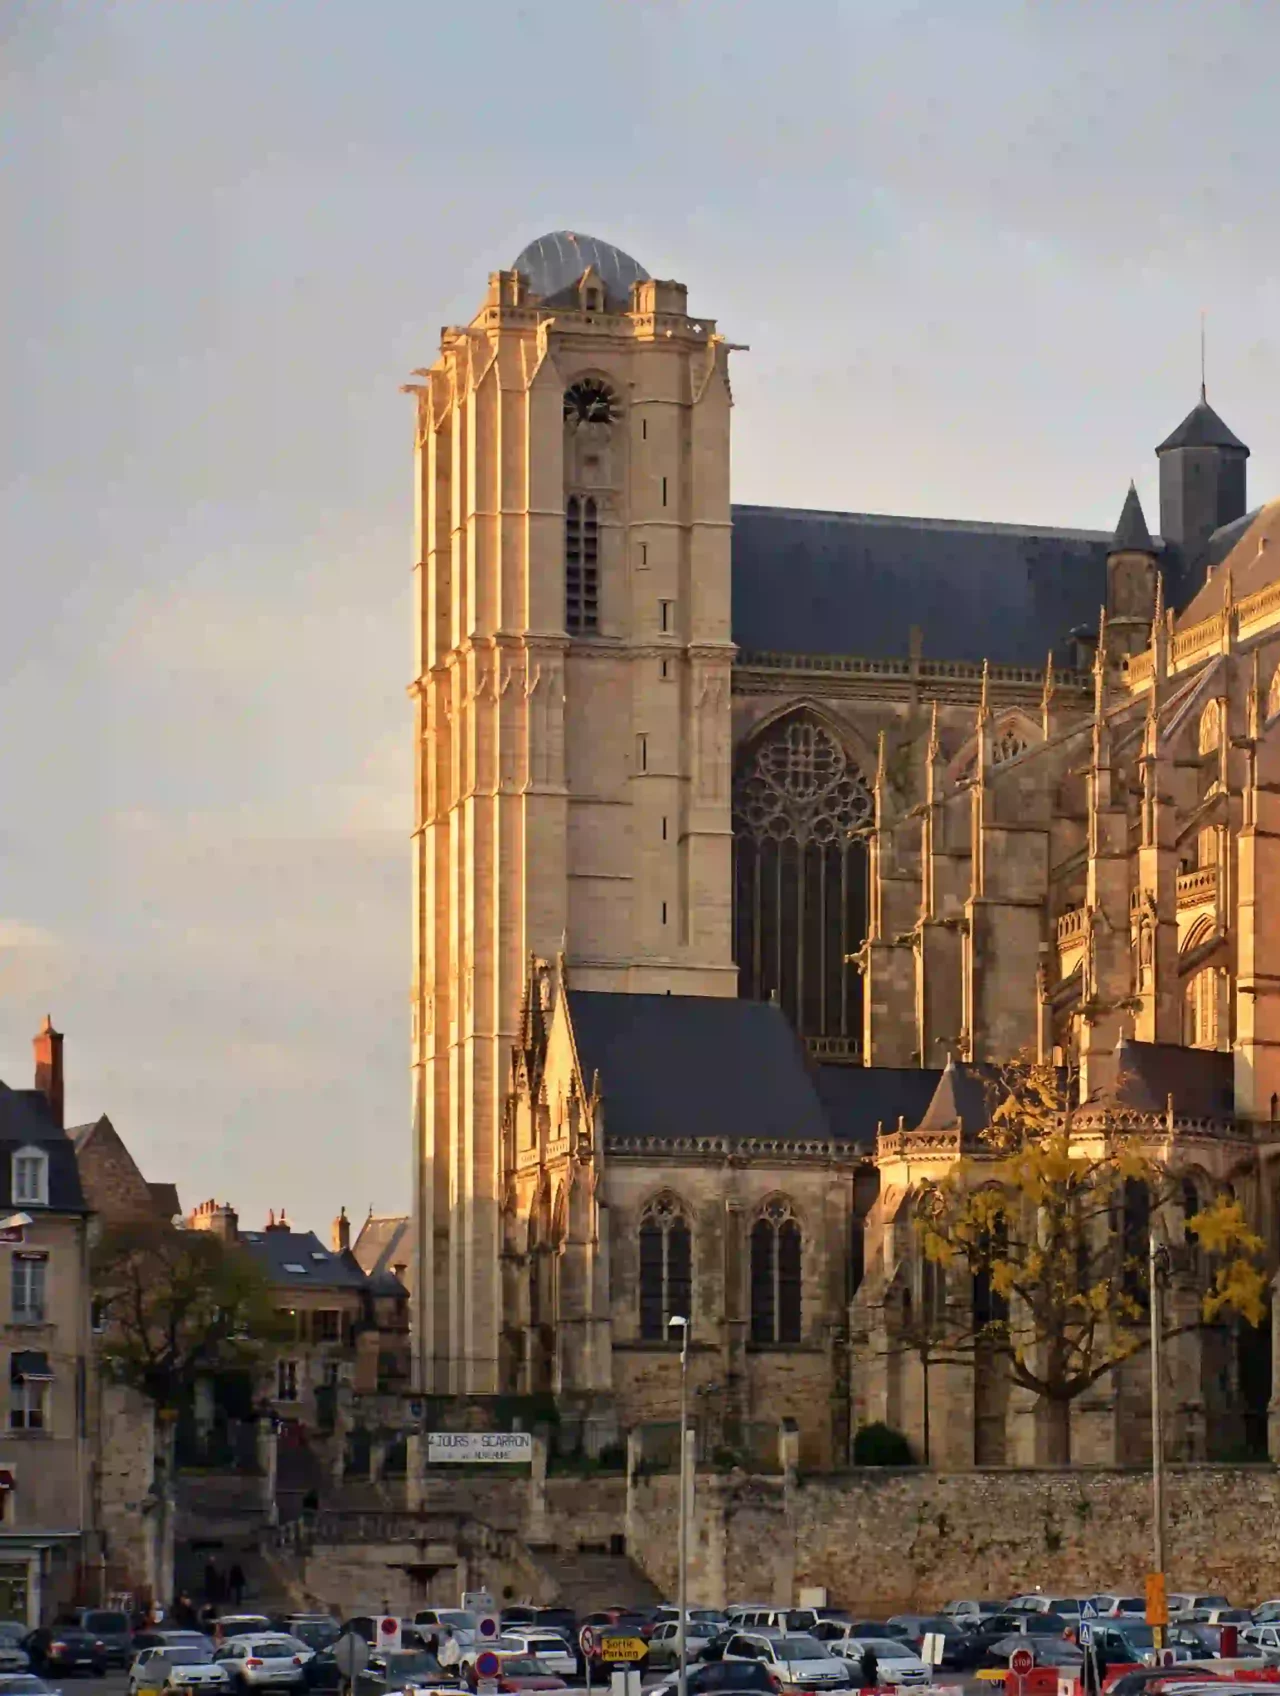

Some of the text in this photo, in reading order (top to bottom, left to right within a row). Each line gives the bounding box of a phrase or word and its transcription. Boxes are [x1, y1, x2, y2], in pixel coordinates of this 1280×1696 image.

[481, 1435, 529, 1447] SCARRON
[606, 1640, 634, 1649] Sortie
[603, 1649, 639, 1659] Parking
[1014, 1658, 1031, 1667] STOP
